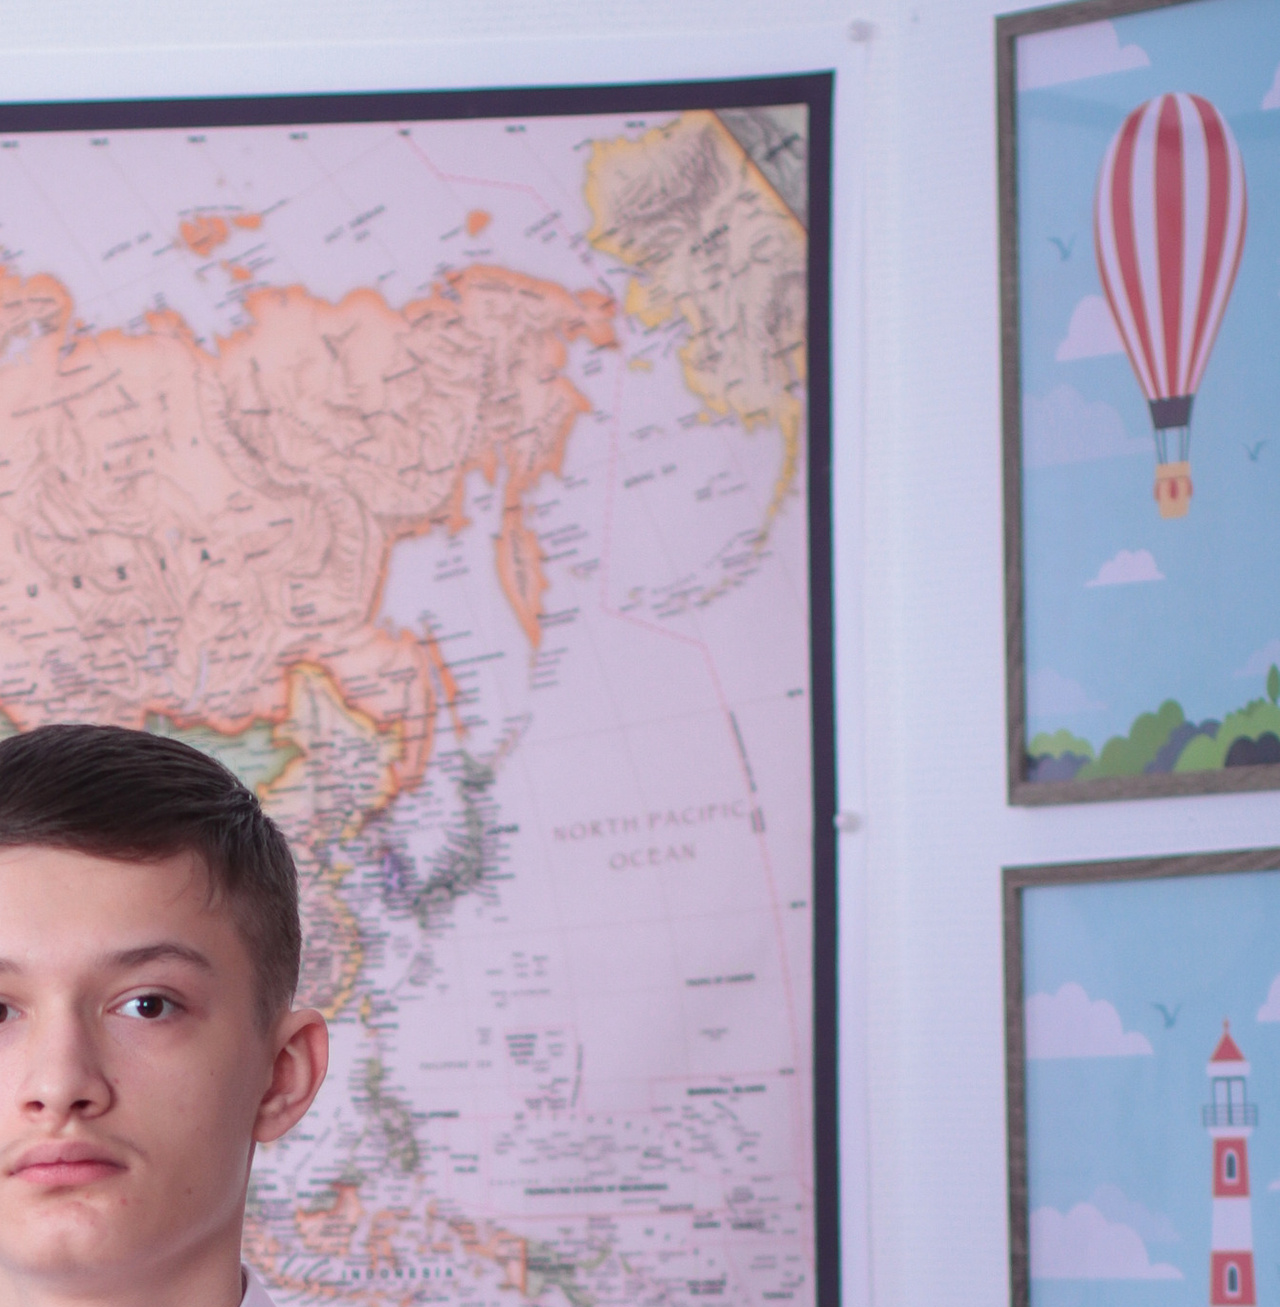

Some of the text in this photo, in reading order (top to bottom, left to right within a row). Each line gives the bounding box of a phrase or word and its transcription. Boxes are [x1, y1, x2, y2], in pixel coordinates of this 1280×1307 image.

[552, 816, 639, 843] NORTH
[646, 799, 747, 830] PACIFIC
[608, 841, 698, 870] OCEAN
[341, 1266, 455, 1281] INDONESIA
